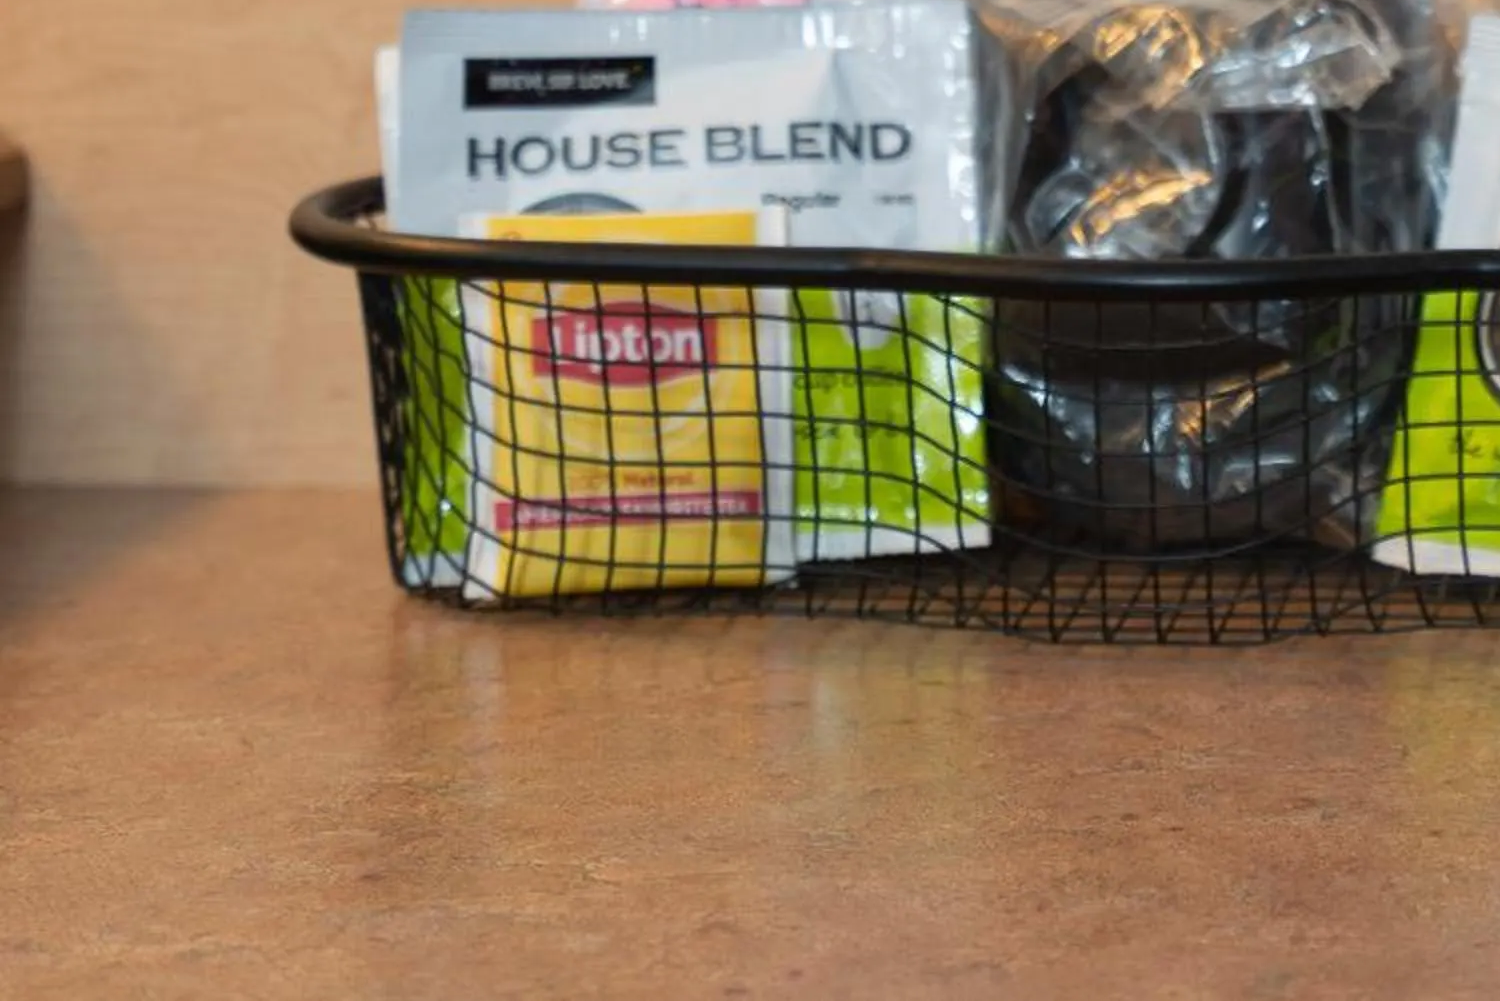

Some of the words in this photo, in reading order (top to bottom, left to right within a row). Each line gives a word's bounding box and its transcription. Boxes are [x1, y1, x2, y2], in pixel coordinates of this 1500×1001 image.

[466, 129, 688, 179] HOUSE
[704, 122, 913, 165] BLEND
[548, 320, 705, 374] Lipton
